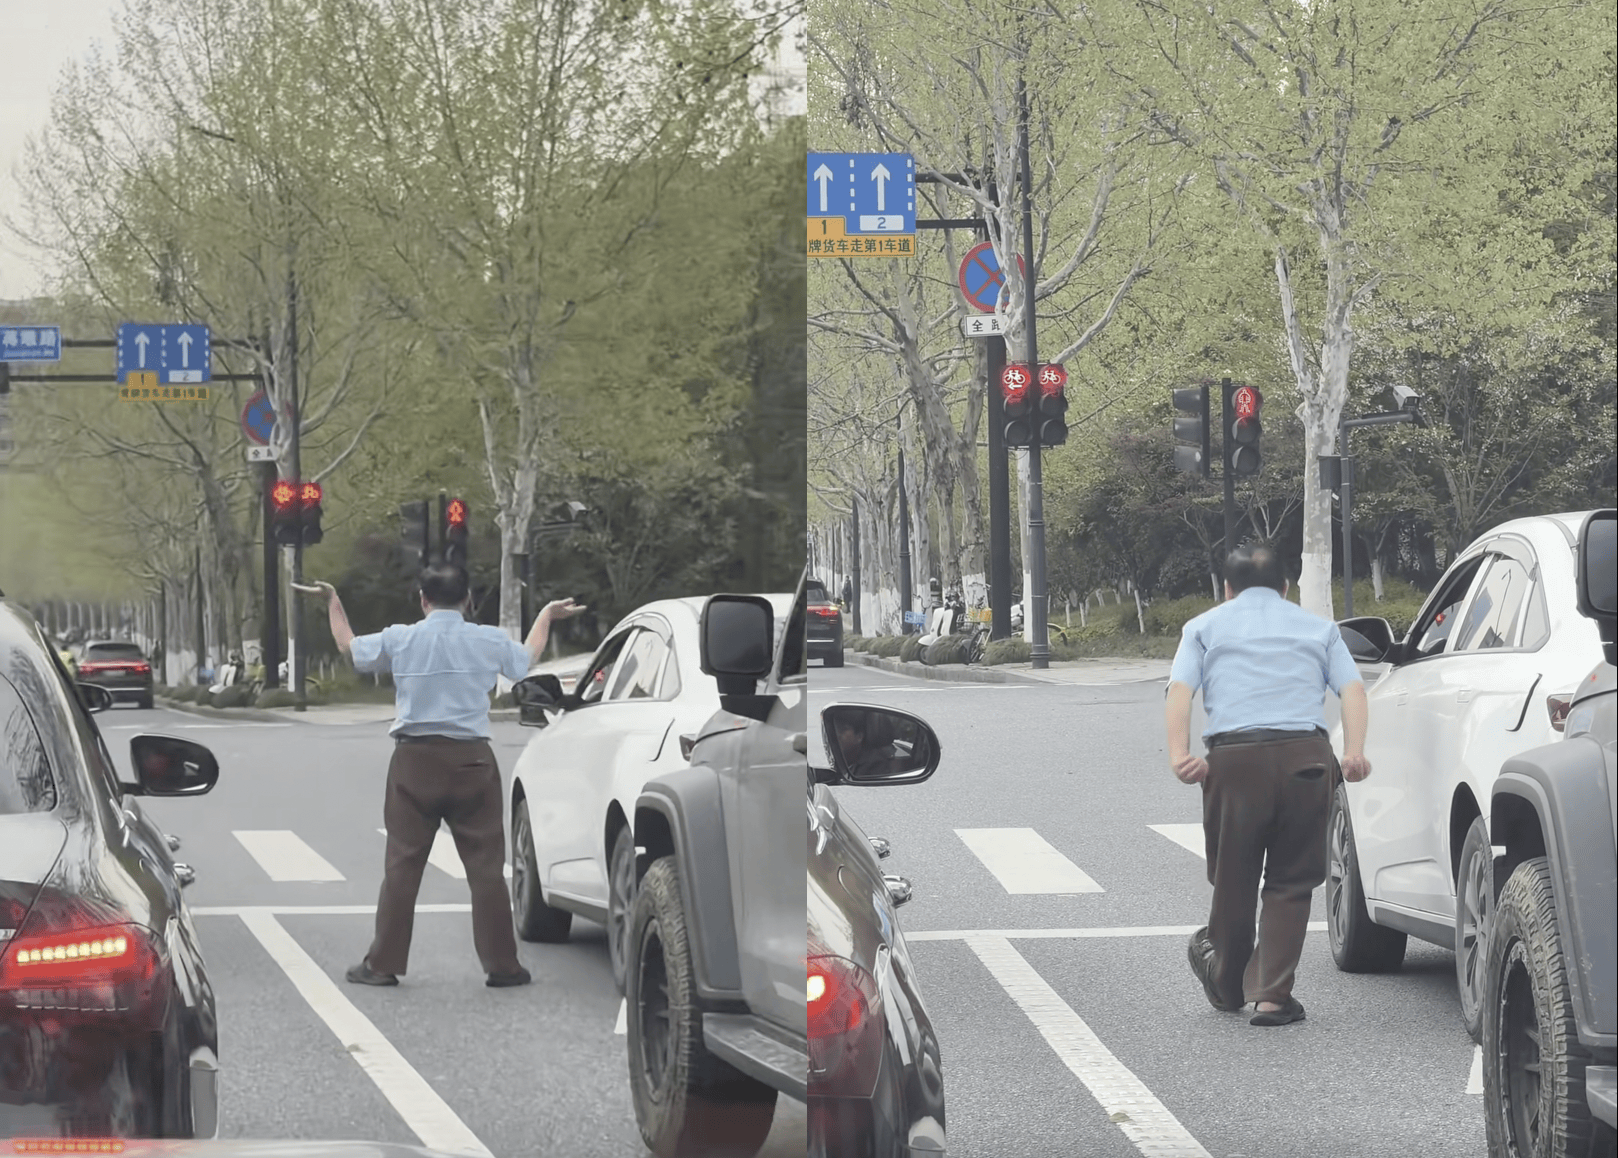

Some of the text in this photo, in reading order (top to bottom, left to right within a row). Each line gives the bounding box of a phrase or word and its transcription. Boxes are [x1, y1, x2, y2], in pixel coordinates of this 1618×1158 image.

[821, 219, 827, 234] 1
[877, 217, 887, 229] 2
[808, 238, 911, 253] 牌货车走第1车道
